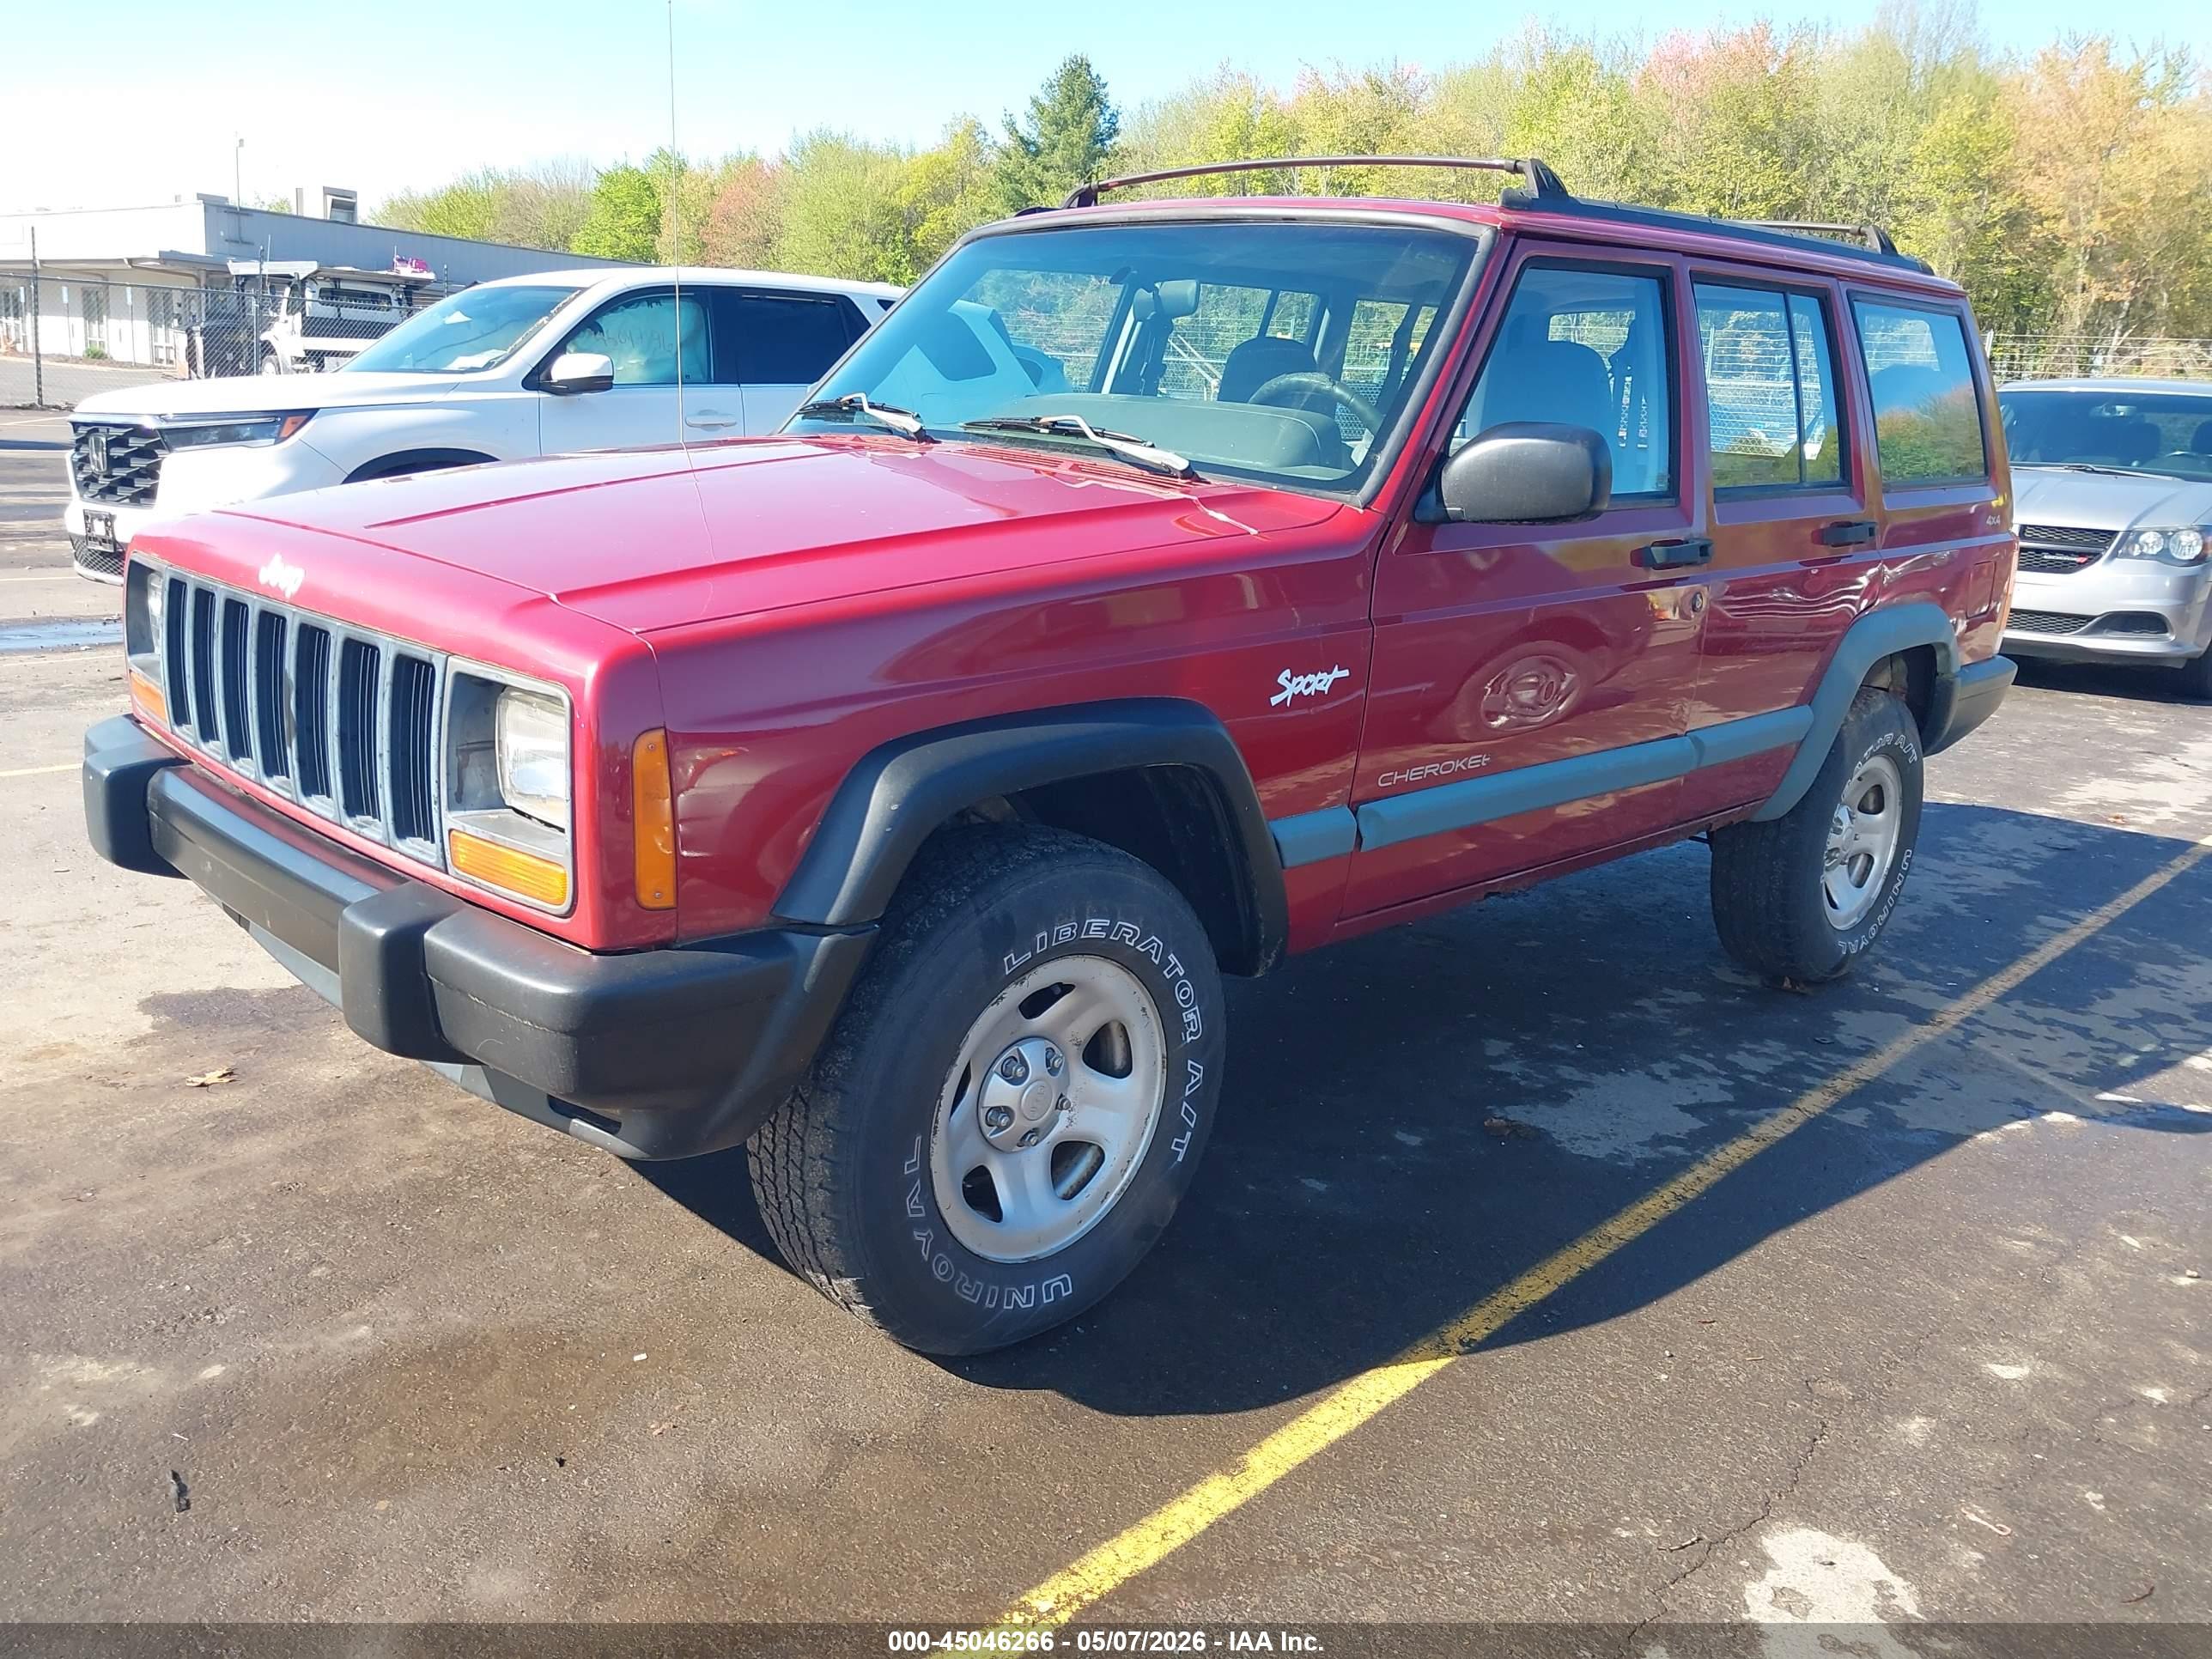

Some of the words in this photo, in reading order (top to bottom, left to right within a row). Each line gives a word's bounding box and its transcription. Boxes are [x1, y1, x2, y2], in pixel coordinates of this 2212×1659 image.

[1838, 848, 1913, 955] UNIROYAL
[1003, 918, 1203, 1044] LIBERATOR
[1170, 1059, 1204, 1163] A/T
[903, 1134, 1073, 1310] UNIROYAL
